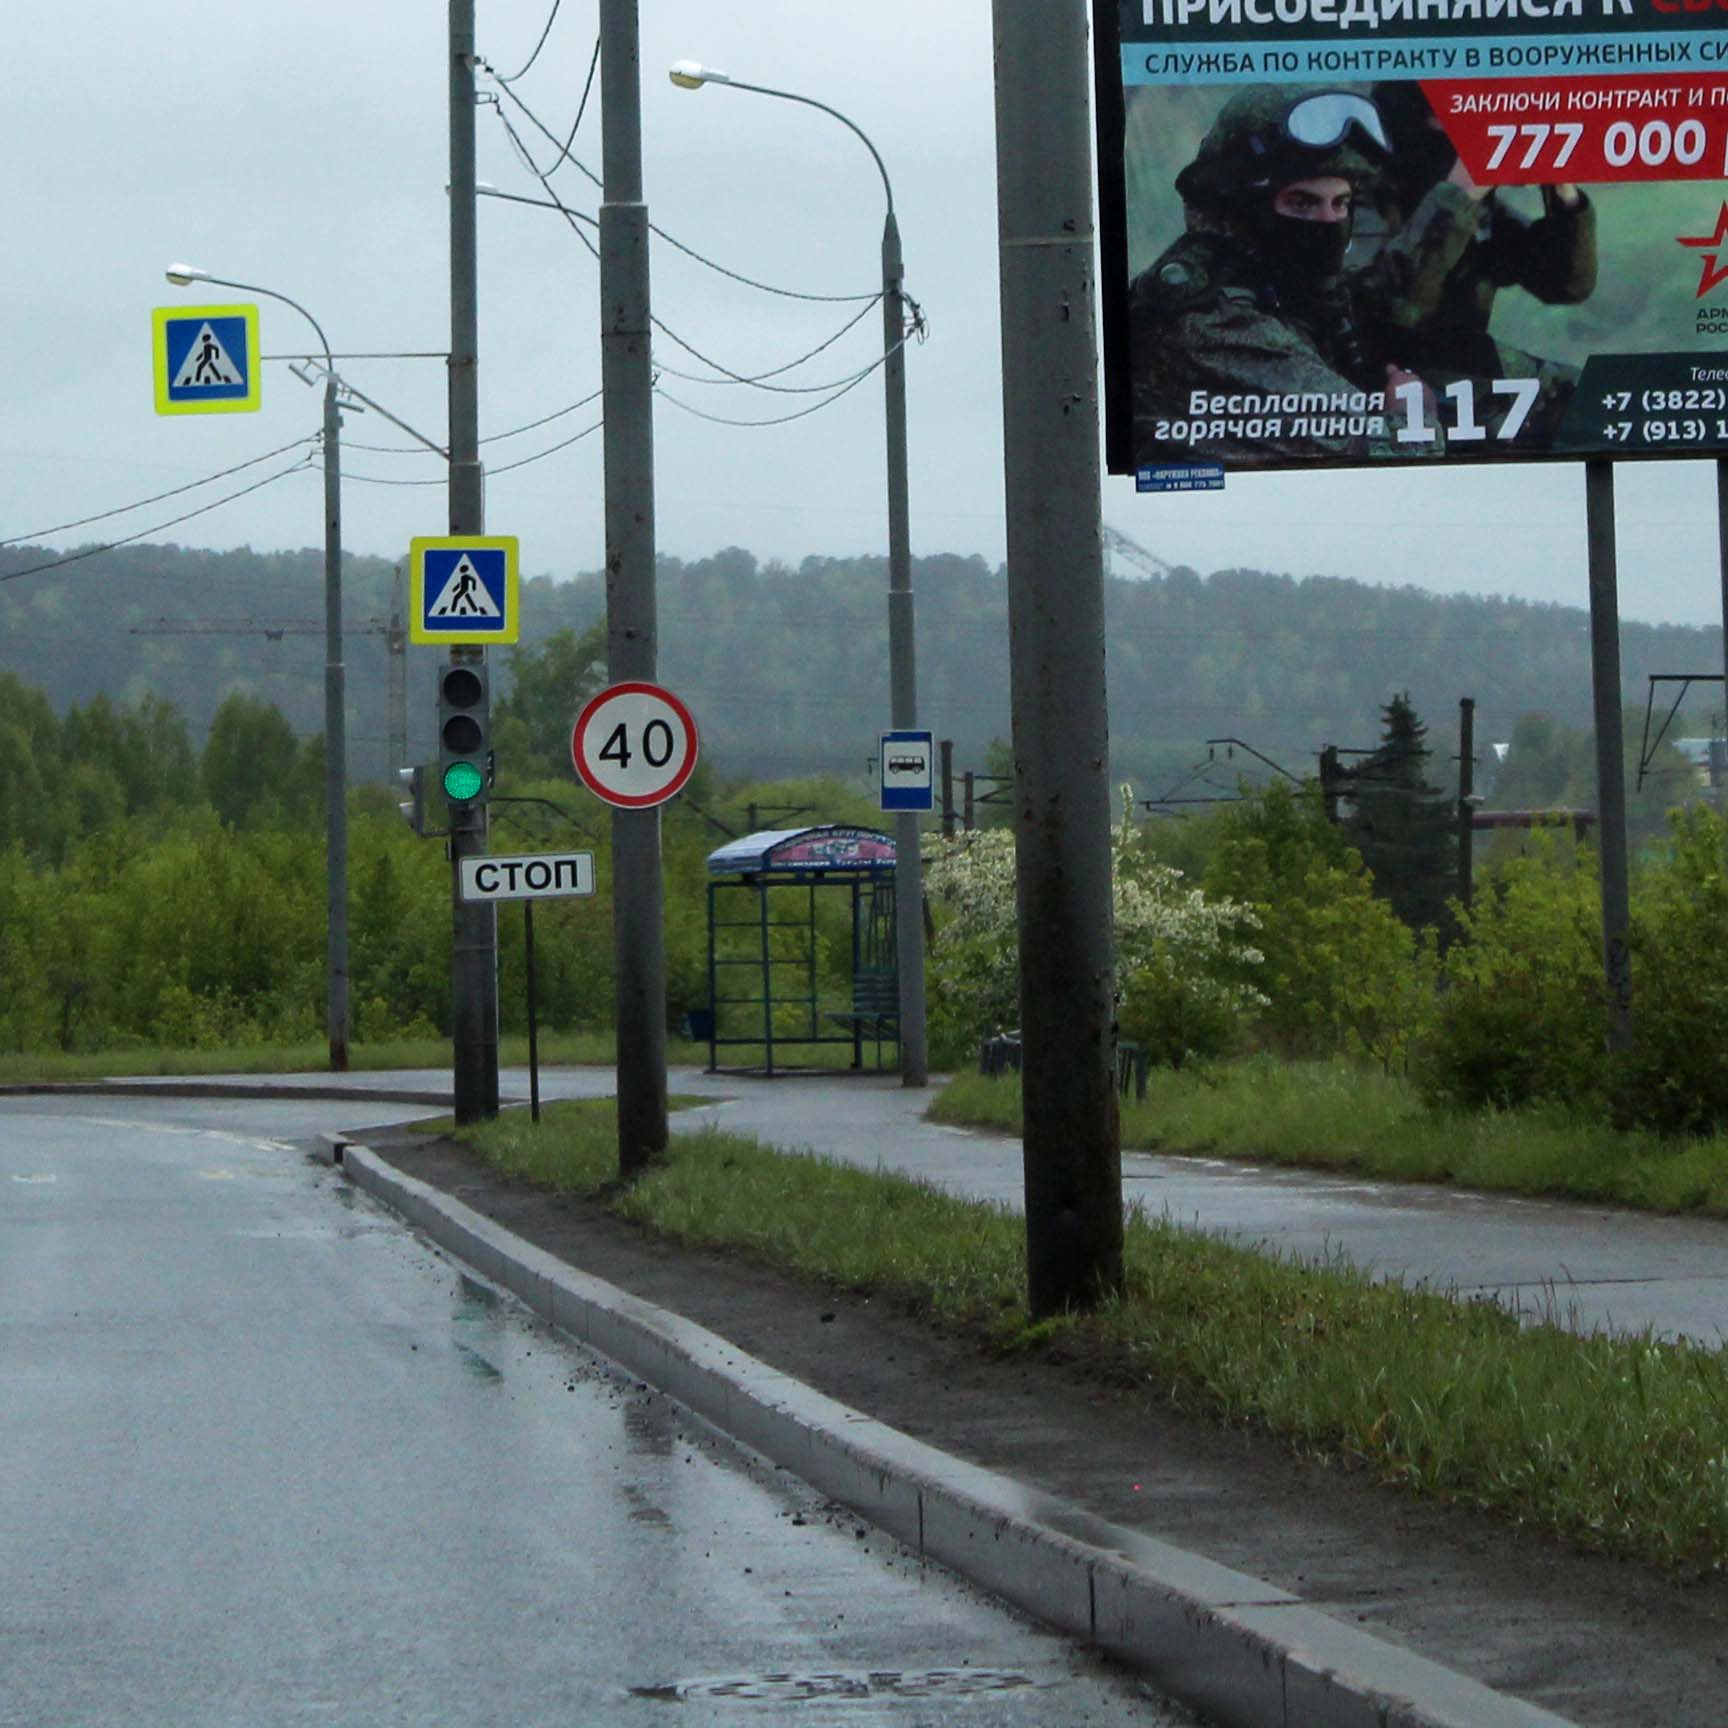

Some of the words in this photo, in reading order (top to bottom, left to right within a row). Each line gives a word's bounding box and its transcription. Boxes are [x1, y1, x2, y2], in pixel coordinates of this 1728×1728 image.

[1146, 49, 1254, 75] СЛУЖБА
[1263, 52, 1298, 72] ПО
[1308, 47, 1456, 71] КОНТРАКТУ
[1466, 47, 1481, 67] В
[1489, 42, 1692, 67] ВООРУЖЕННЫХ
[1451, 89, 1560, 114] ЗАКЛЮЧИ
[1568, 86, 1679, 110] КОНТРАКТ
[1688, 86, 1703, 106] И
[1484, 122, 1584, 171] 777
[1603, 120, 1704, 166] 000
[1189, 388, 1384, 414] Бесплатная
[1394, 380, 1541, 442] 117
[1602, 392, 1631, 411] +7
[1642, 388, 1726, 413] (3822)
[1154, 416, 1283, 442] горячая
[1291, 413, 1383, 440] линия
[1603, 421, 1632, 440] +7
[1642, 418, 1706, 442] (913)
[599, 719, 674, 770] 40
[475, 860, 578, 892] СТОП
